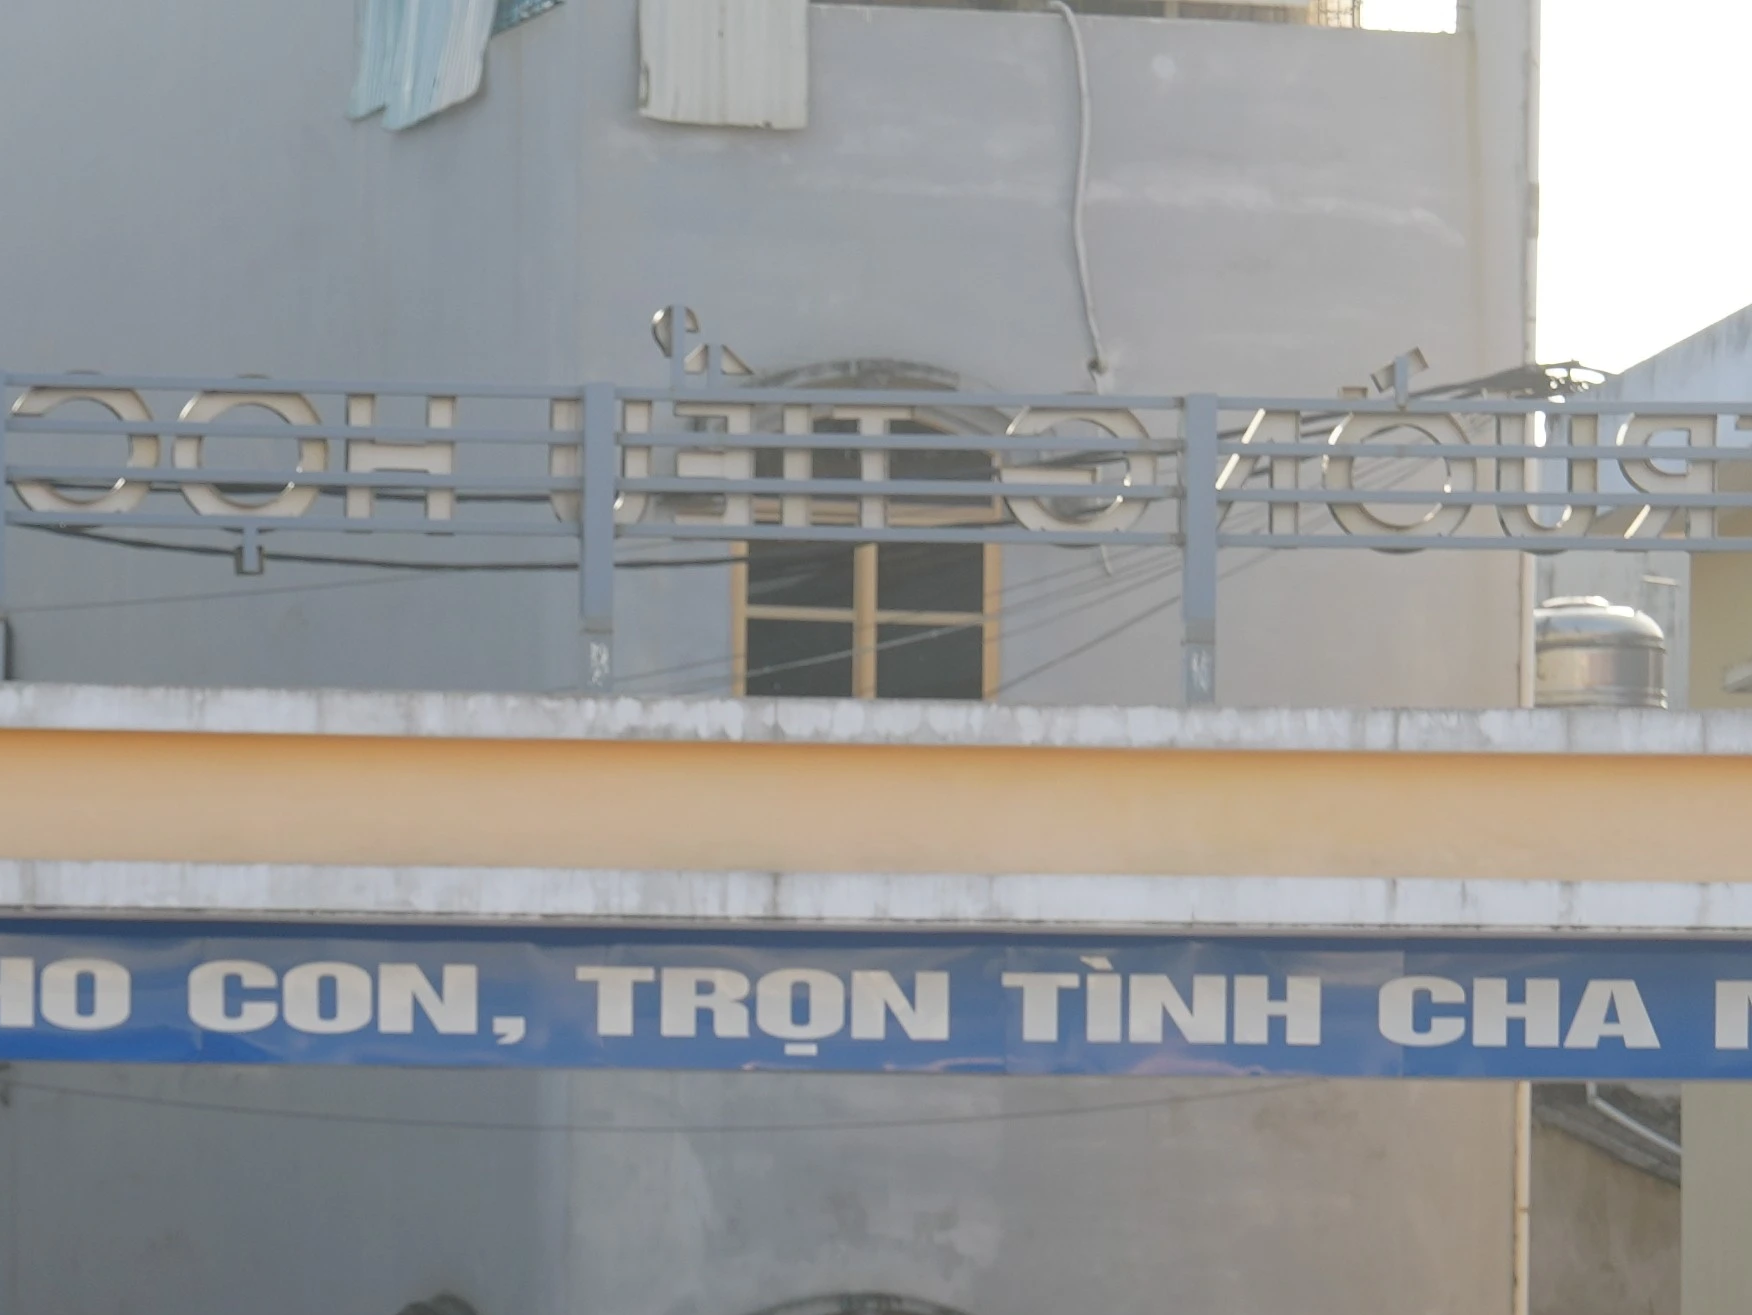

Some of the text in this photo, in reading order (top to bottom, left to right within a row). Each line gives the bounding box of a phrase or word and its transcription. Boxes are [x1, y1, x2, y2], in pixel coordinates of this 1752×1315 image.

[186, 960, 528, 1045] CON,
[575, 963, 950, 1056] TRỌN
[1001, 956, 1324, 1046] TÌNH
[1376, 976, 1662, 1050] CHA
